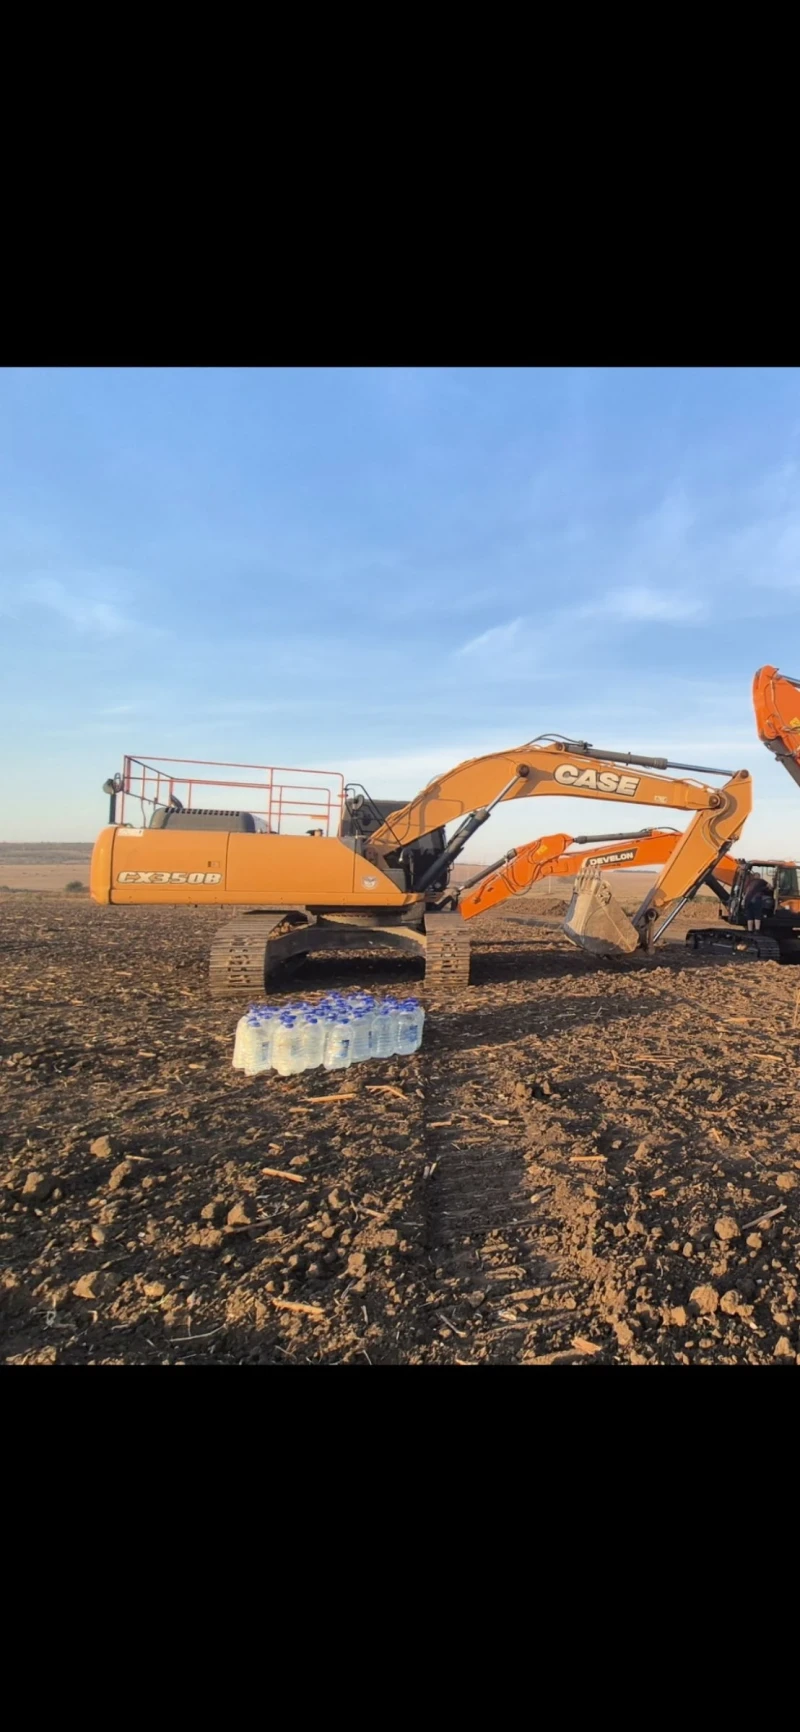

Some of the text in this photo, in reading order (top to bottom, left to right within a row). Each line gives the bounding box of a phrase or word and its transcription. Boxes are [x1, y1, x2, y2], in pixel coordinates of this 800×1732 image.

[553, 763, 641, 797] CASE
[589, 852, 634, 866] DEVELON
[117, 871, 223, 885] CX350B
